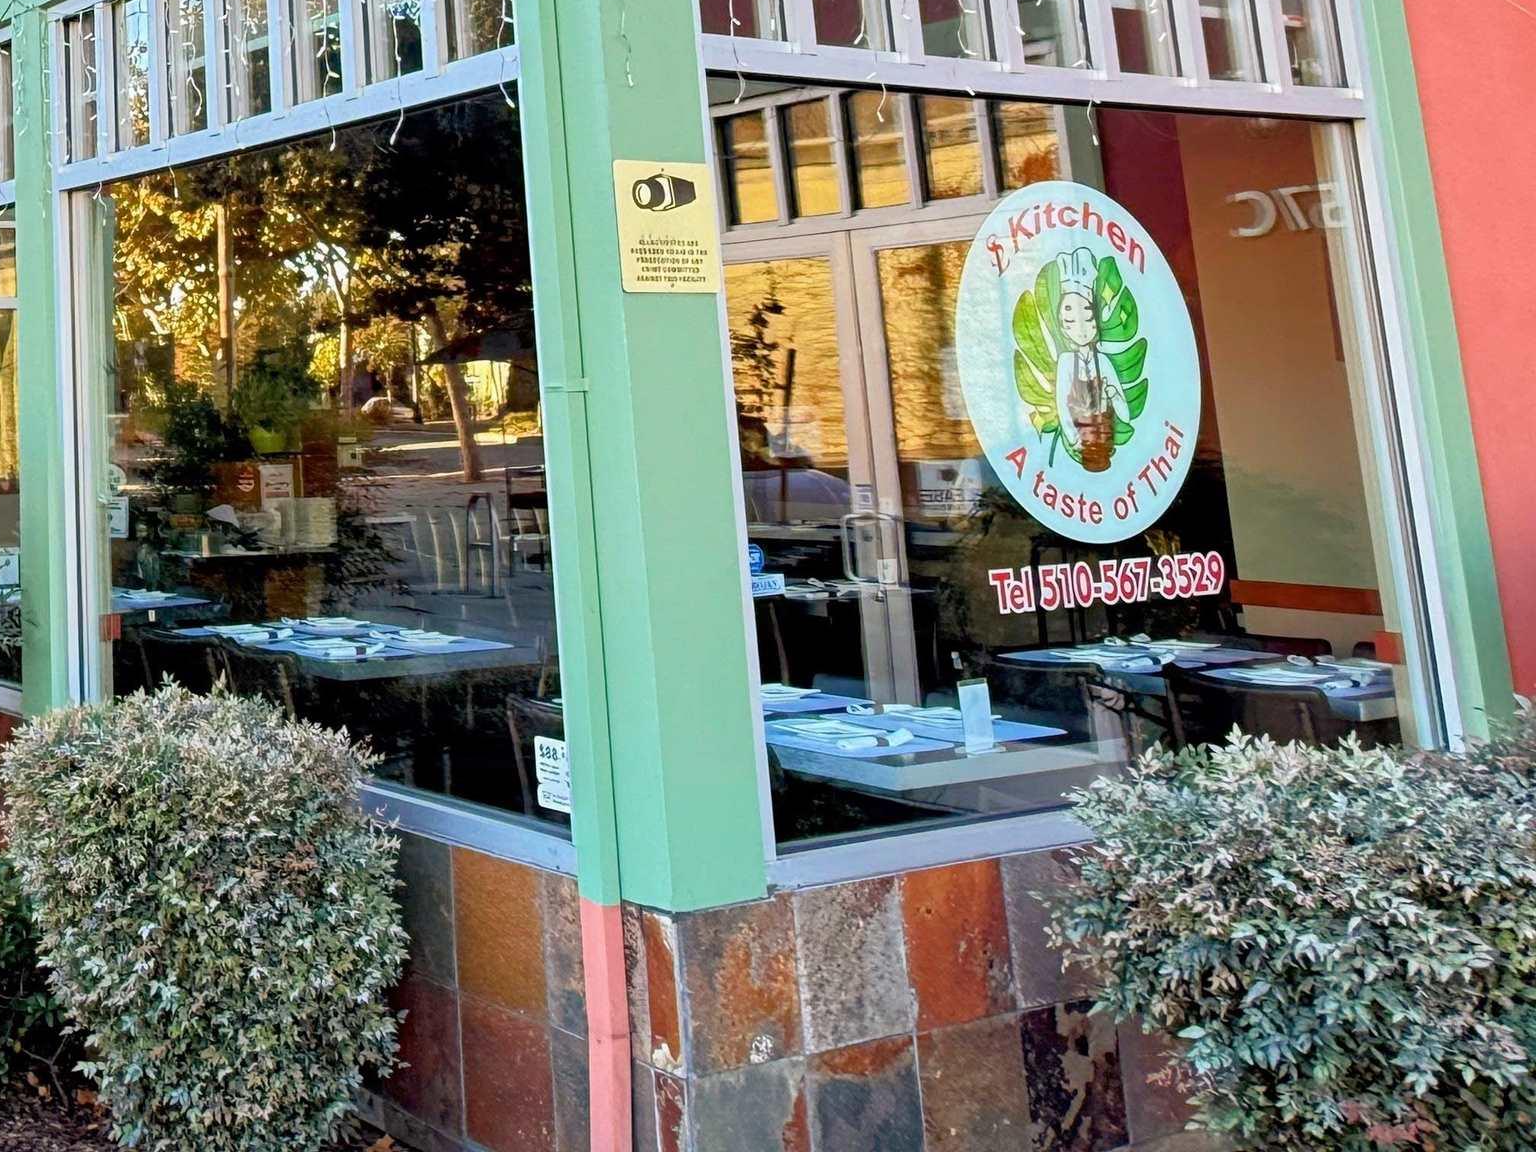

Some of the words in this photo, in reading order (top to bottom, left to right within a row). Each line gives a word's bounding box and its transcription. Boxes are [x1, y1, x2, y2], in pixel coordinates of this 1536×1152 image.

[1008, 201, 1146, 275] Kitchen
[1005, 446, 1027, 480] A
[1033, 469, 1103, 525] taste
[1114, 481, 1139, 521] of
[1138, 420, 1185, 497] Thai
[990, 568, 1034, 612] Tel
[1040, 552, 1224, 610] 510-567-3529
